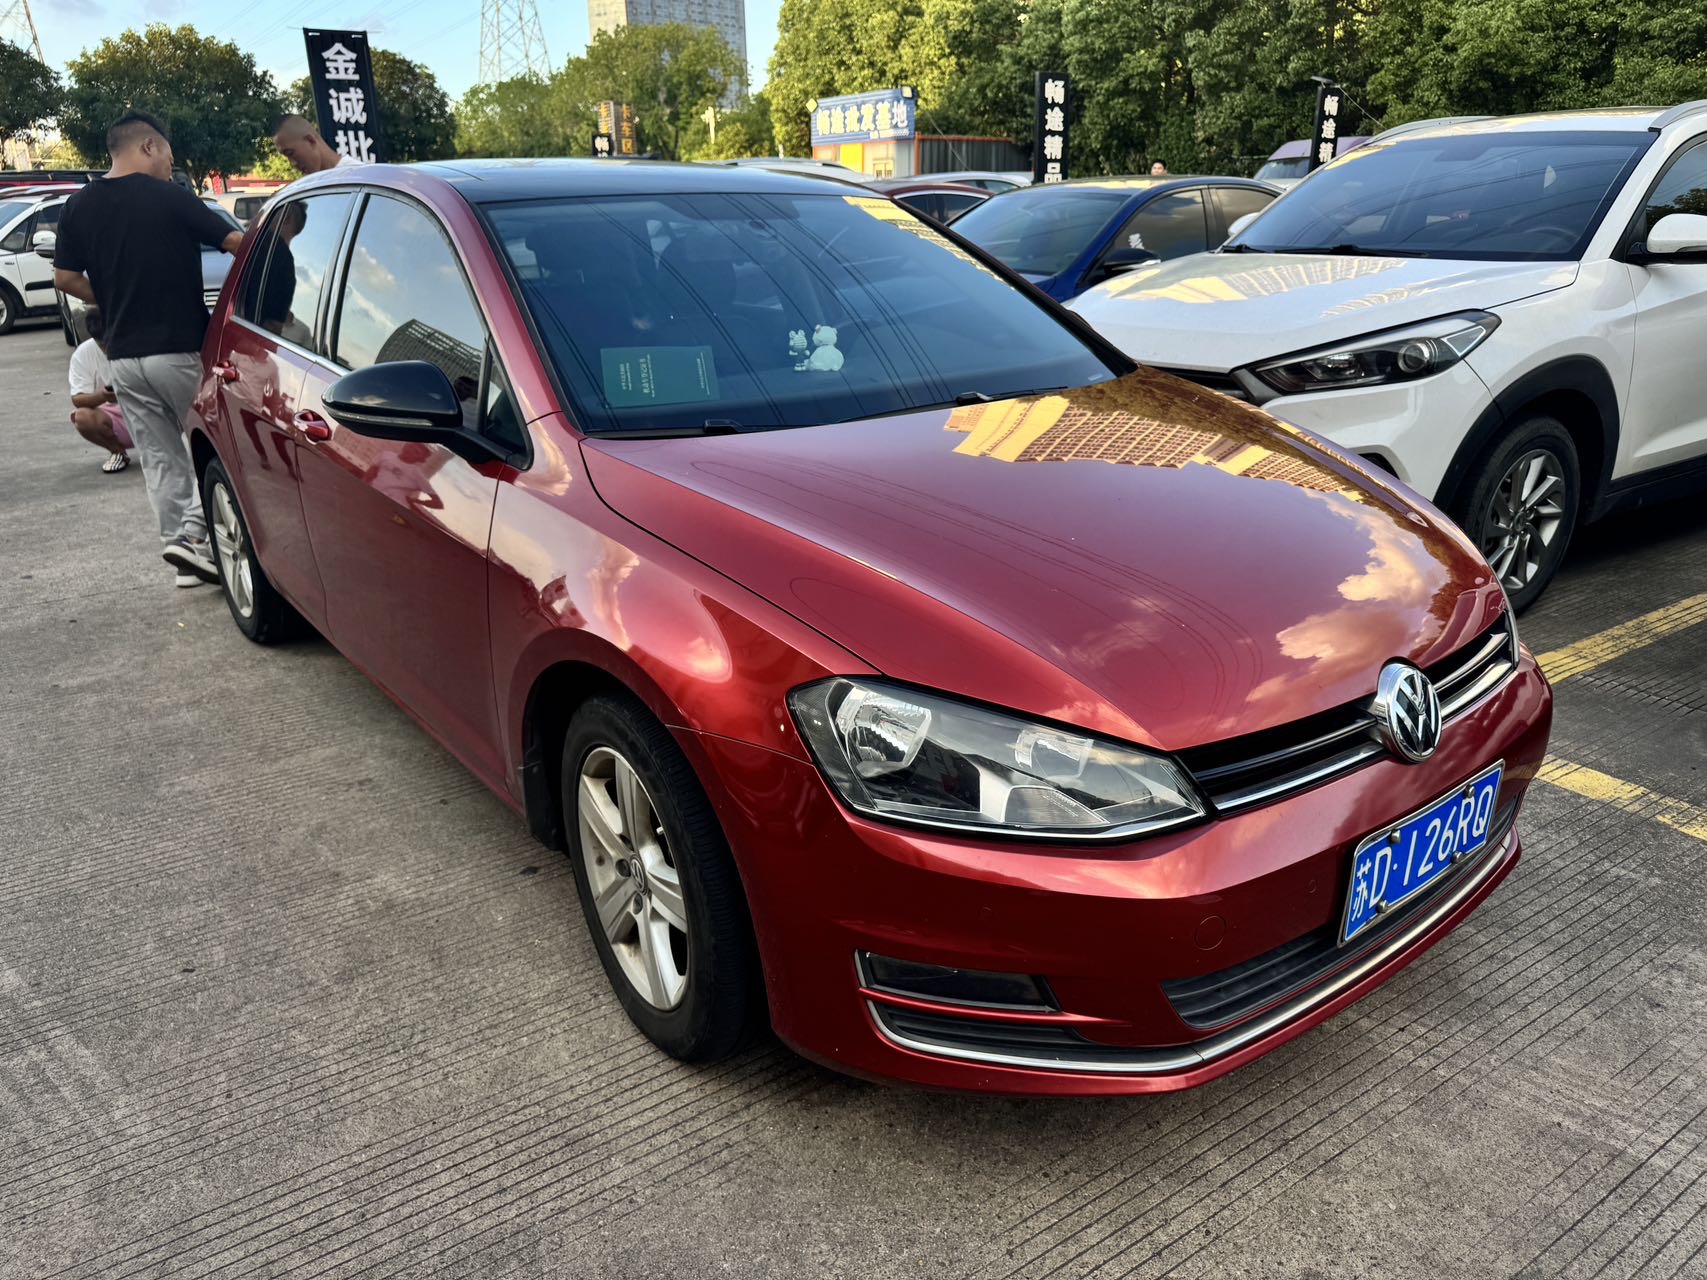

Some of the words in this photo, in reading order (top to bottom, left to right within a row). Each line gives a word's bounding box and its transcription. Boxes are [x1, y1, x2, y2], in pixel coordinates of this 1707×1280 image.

[321, 42, 376, 164] 金诚批
[816, 100, 908, 136] 畅途批发基地
[1044, 78, 1065, 184] 畅途精品
[1319, 94, 1340, 163] 畅途精
